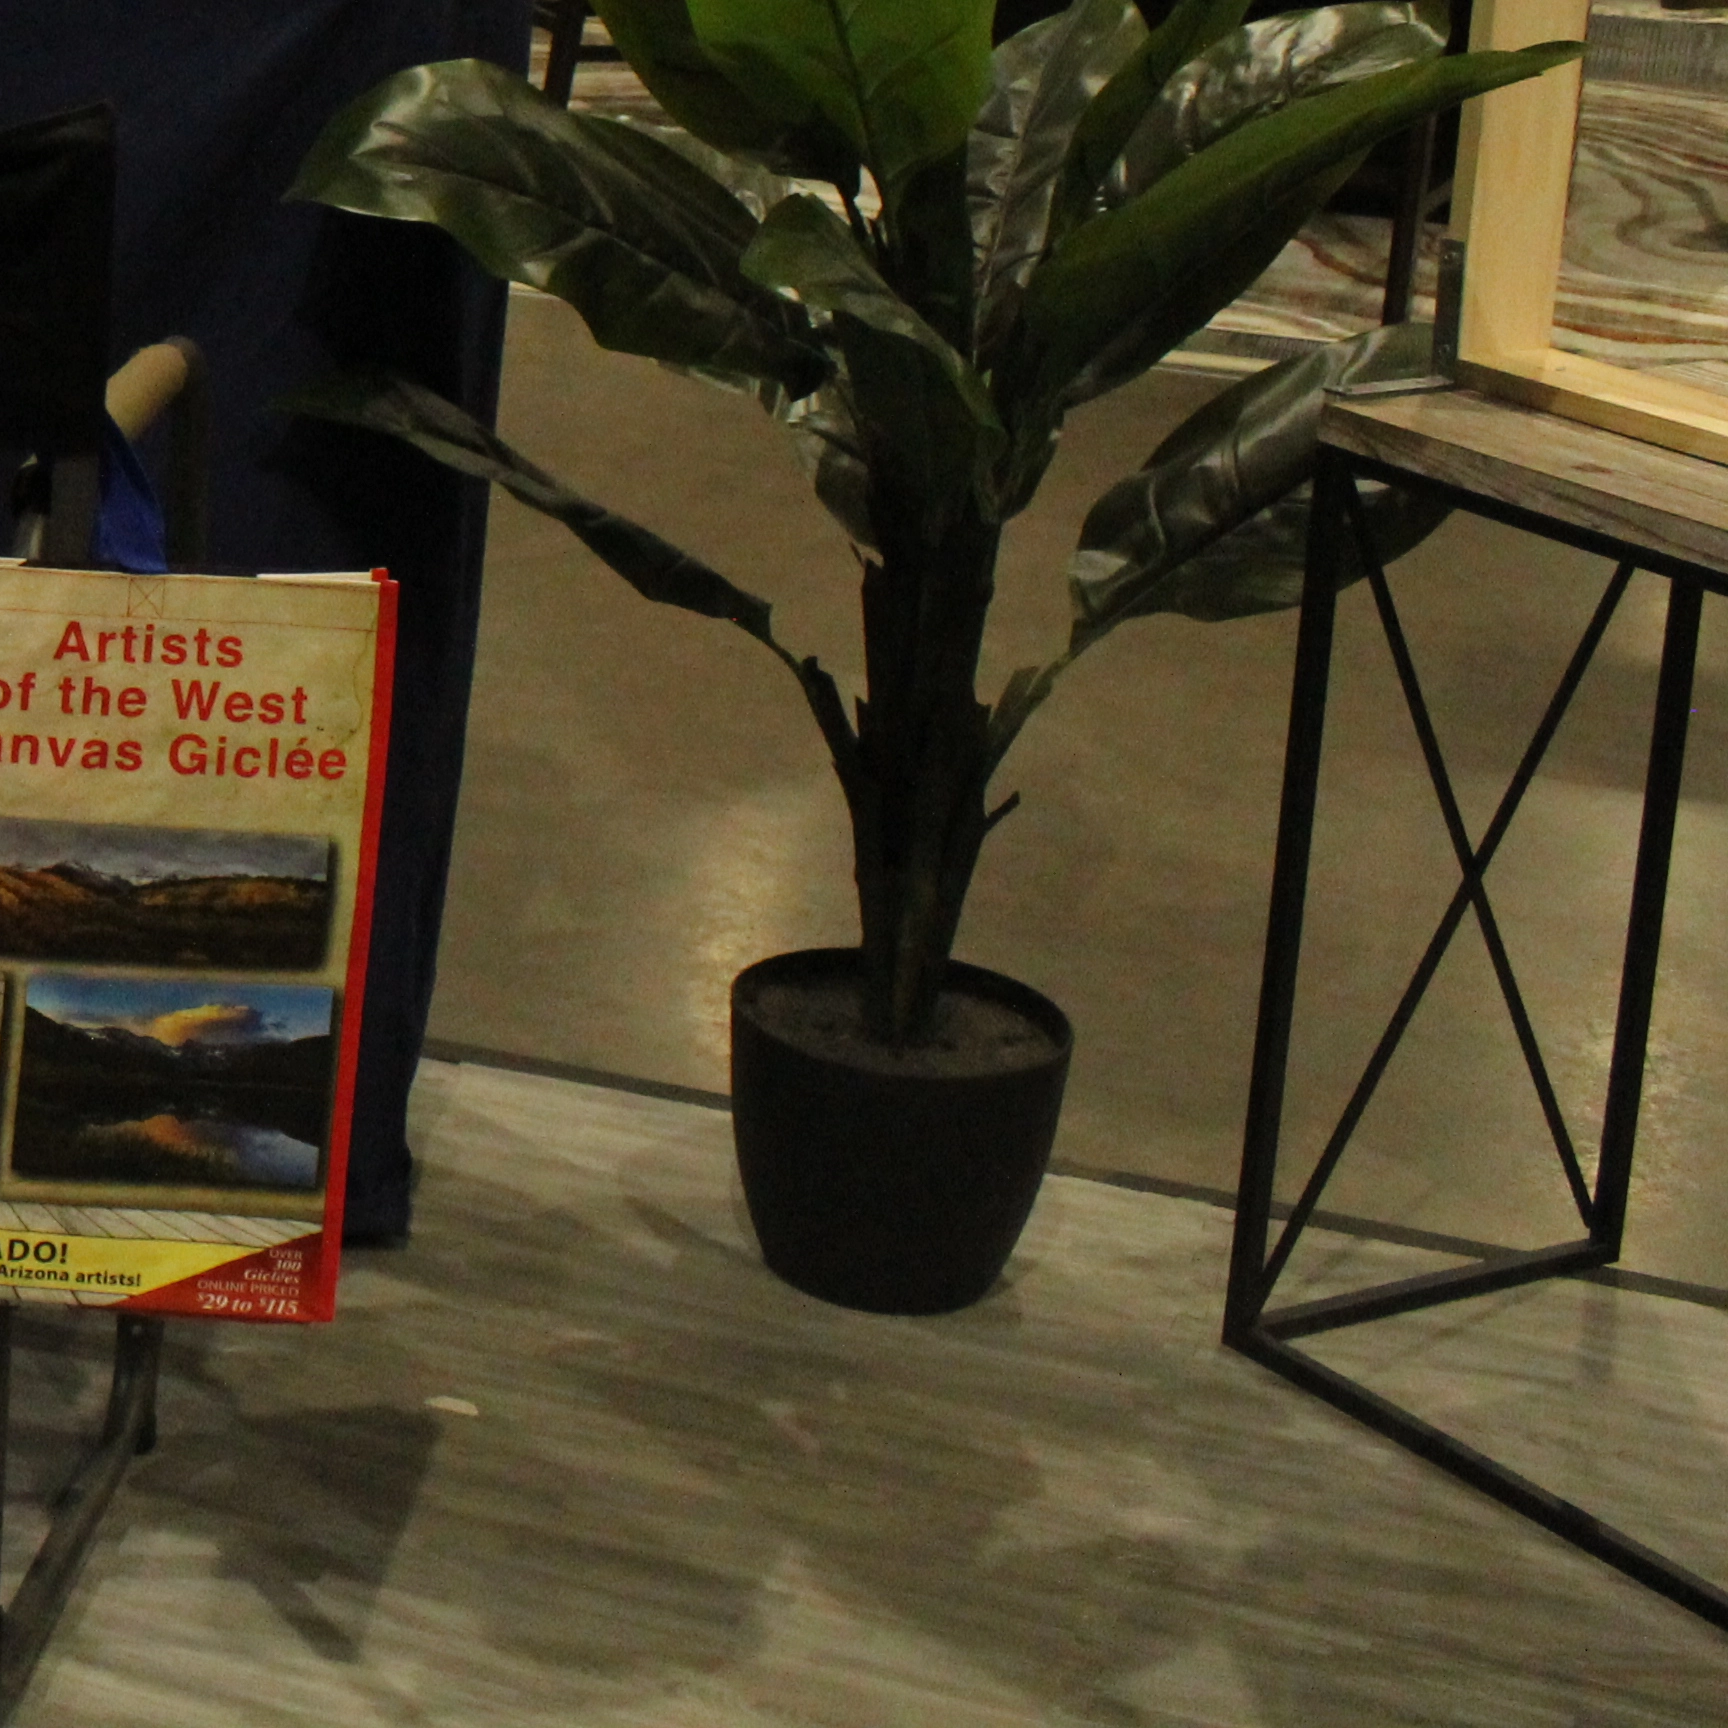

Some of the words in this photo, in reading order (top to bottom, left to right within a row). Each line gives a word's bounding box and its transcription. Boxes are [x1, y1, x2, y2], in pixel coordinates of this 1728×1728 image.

[53, 620, 244, 669] Artists
[58, 676, 148, 718] the
[170, 678, 309, 725] West
[168, 733, 348, 780] Giclée
[75, 1270, 142, 1287] artists!
[196, 1279, 248, 1292] ONLINE
[250, 1281, 300, 1297] PRICED
[231, 1298, 253, 1312] to
